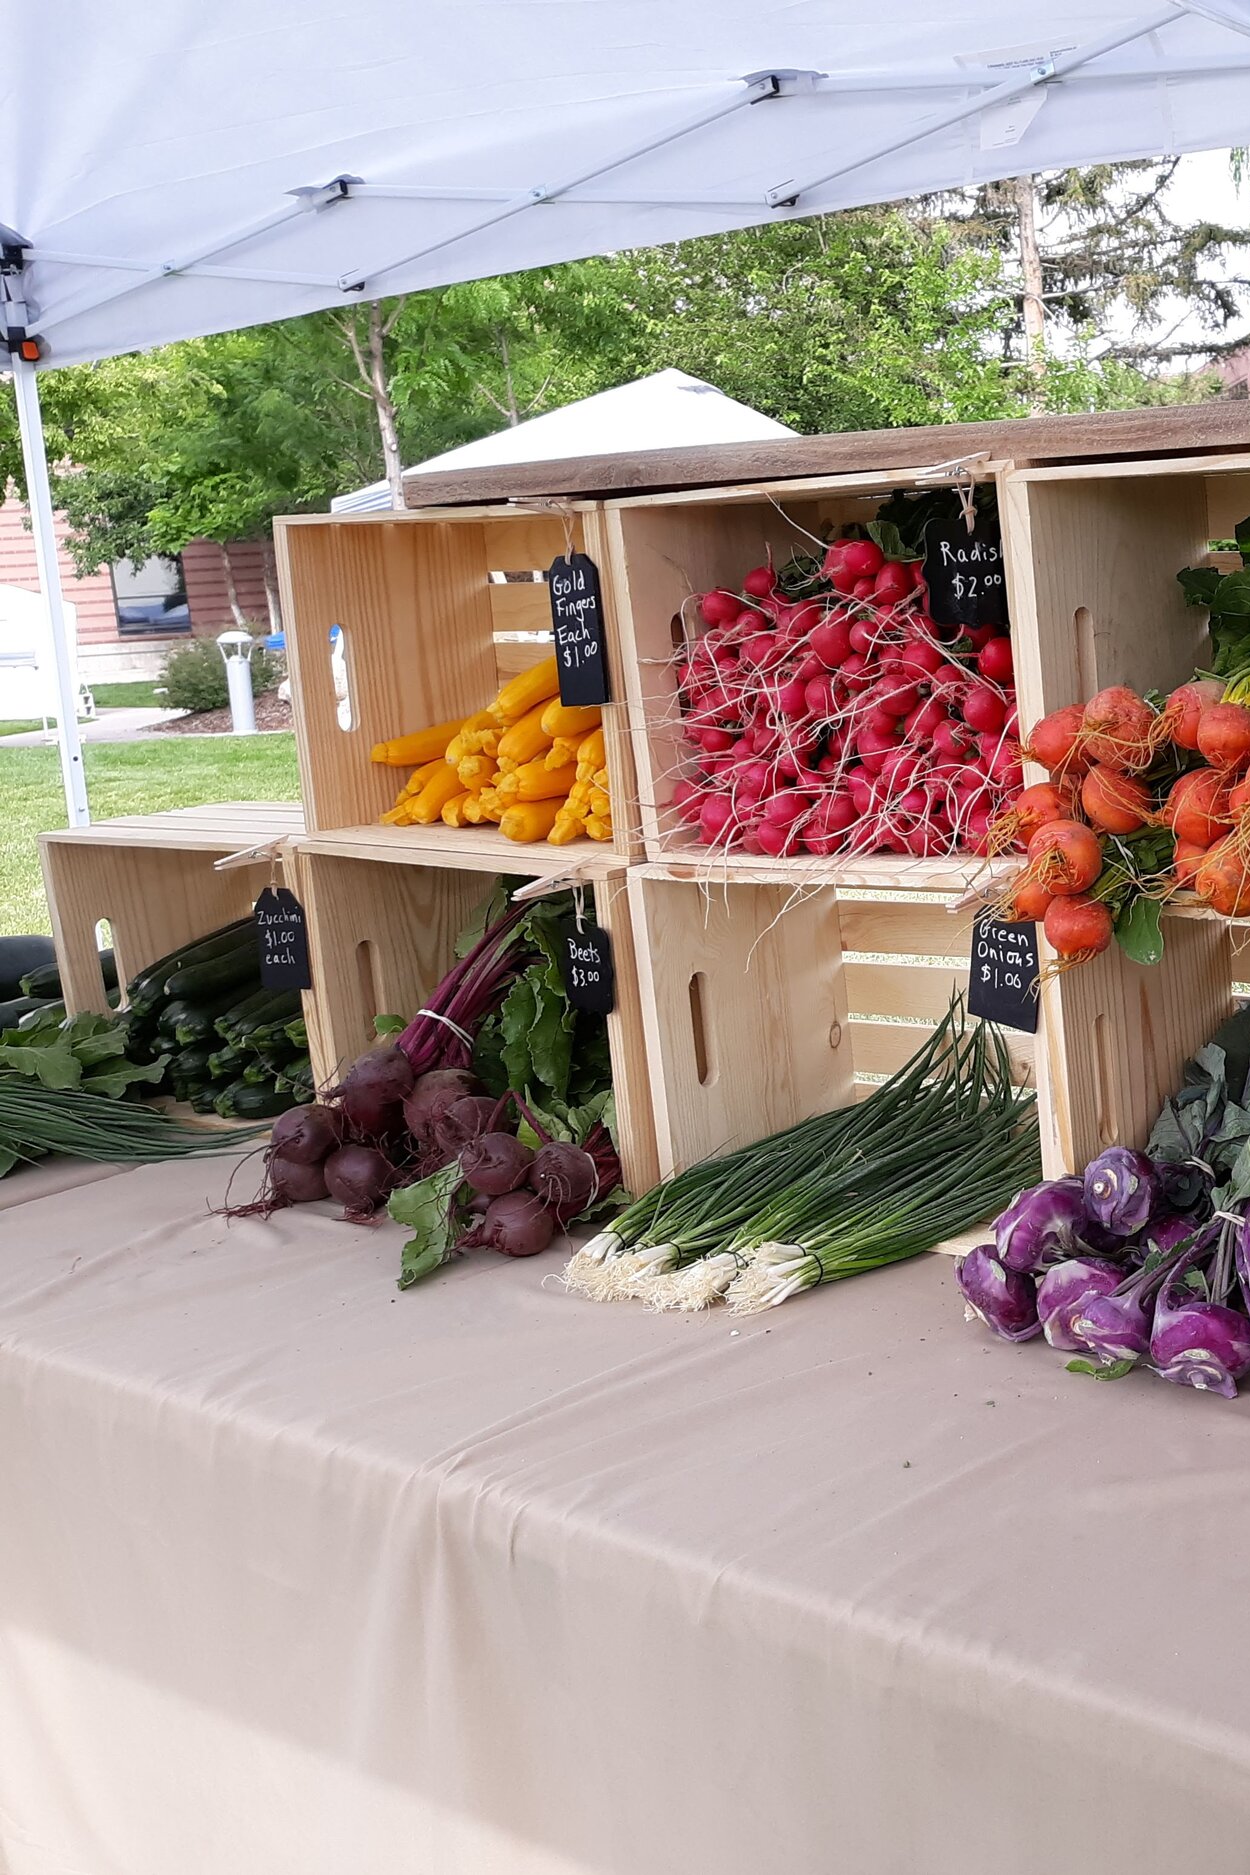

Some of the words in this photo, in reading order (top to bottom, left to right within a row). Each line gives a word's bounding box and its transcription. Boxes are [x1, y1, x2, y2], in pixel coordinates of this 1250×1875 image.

[552, 569, 586, 596] Gold
[951, 572, 1002, 600] $2.00
[556, 595, 596, 623] Fingers
[557, 621, 591, 646] Each
[563, 641, 598, 668] $1.00
[256, 905, 302, 926] Zucchini
[264, 928, 295, 950] $1.00
[979, 919, 1029, 947] Green
[265, 946, 296, 965] each
[567, 937, 601, 964] Beets
[977, 941, 1034, 968] Onions
[571, 965, 600, 988] $3.00
